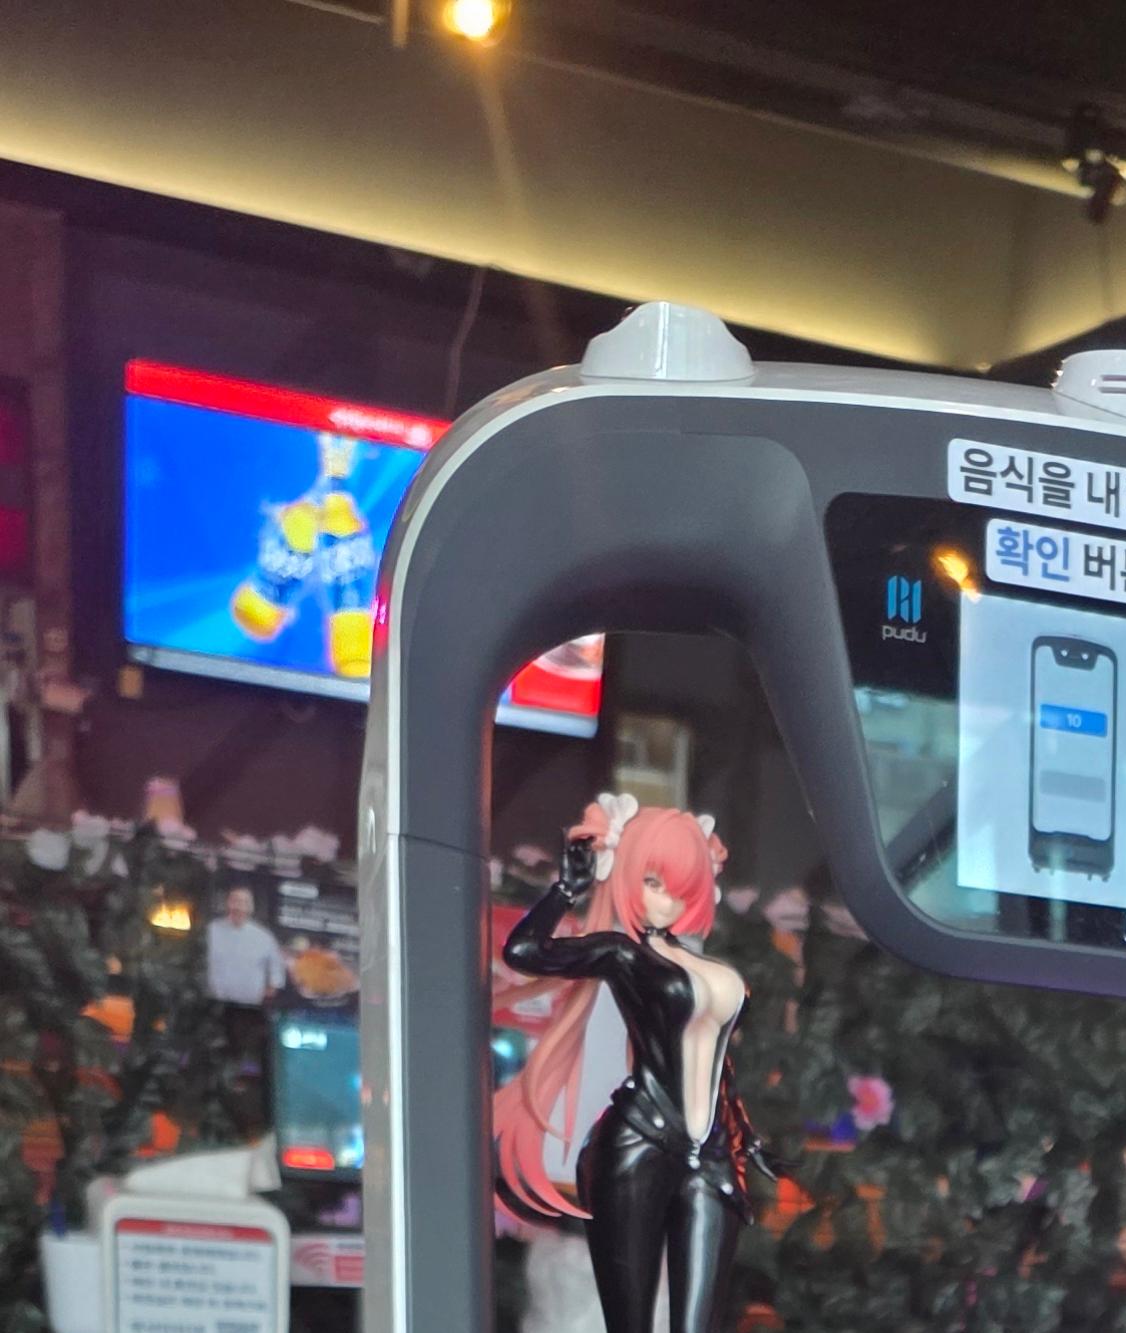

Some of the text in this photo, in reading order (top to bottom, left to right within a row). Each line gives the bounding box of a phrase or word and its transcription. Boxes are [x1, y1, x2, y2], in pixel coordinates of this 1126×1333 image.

[959, 448, 1076, 510] 음식을
[995, 526, 1070, 583] 확인
[882, 624, 927, 644] pudu
[1066, 713, 1082, 728] 10
